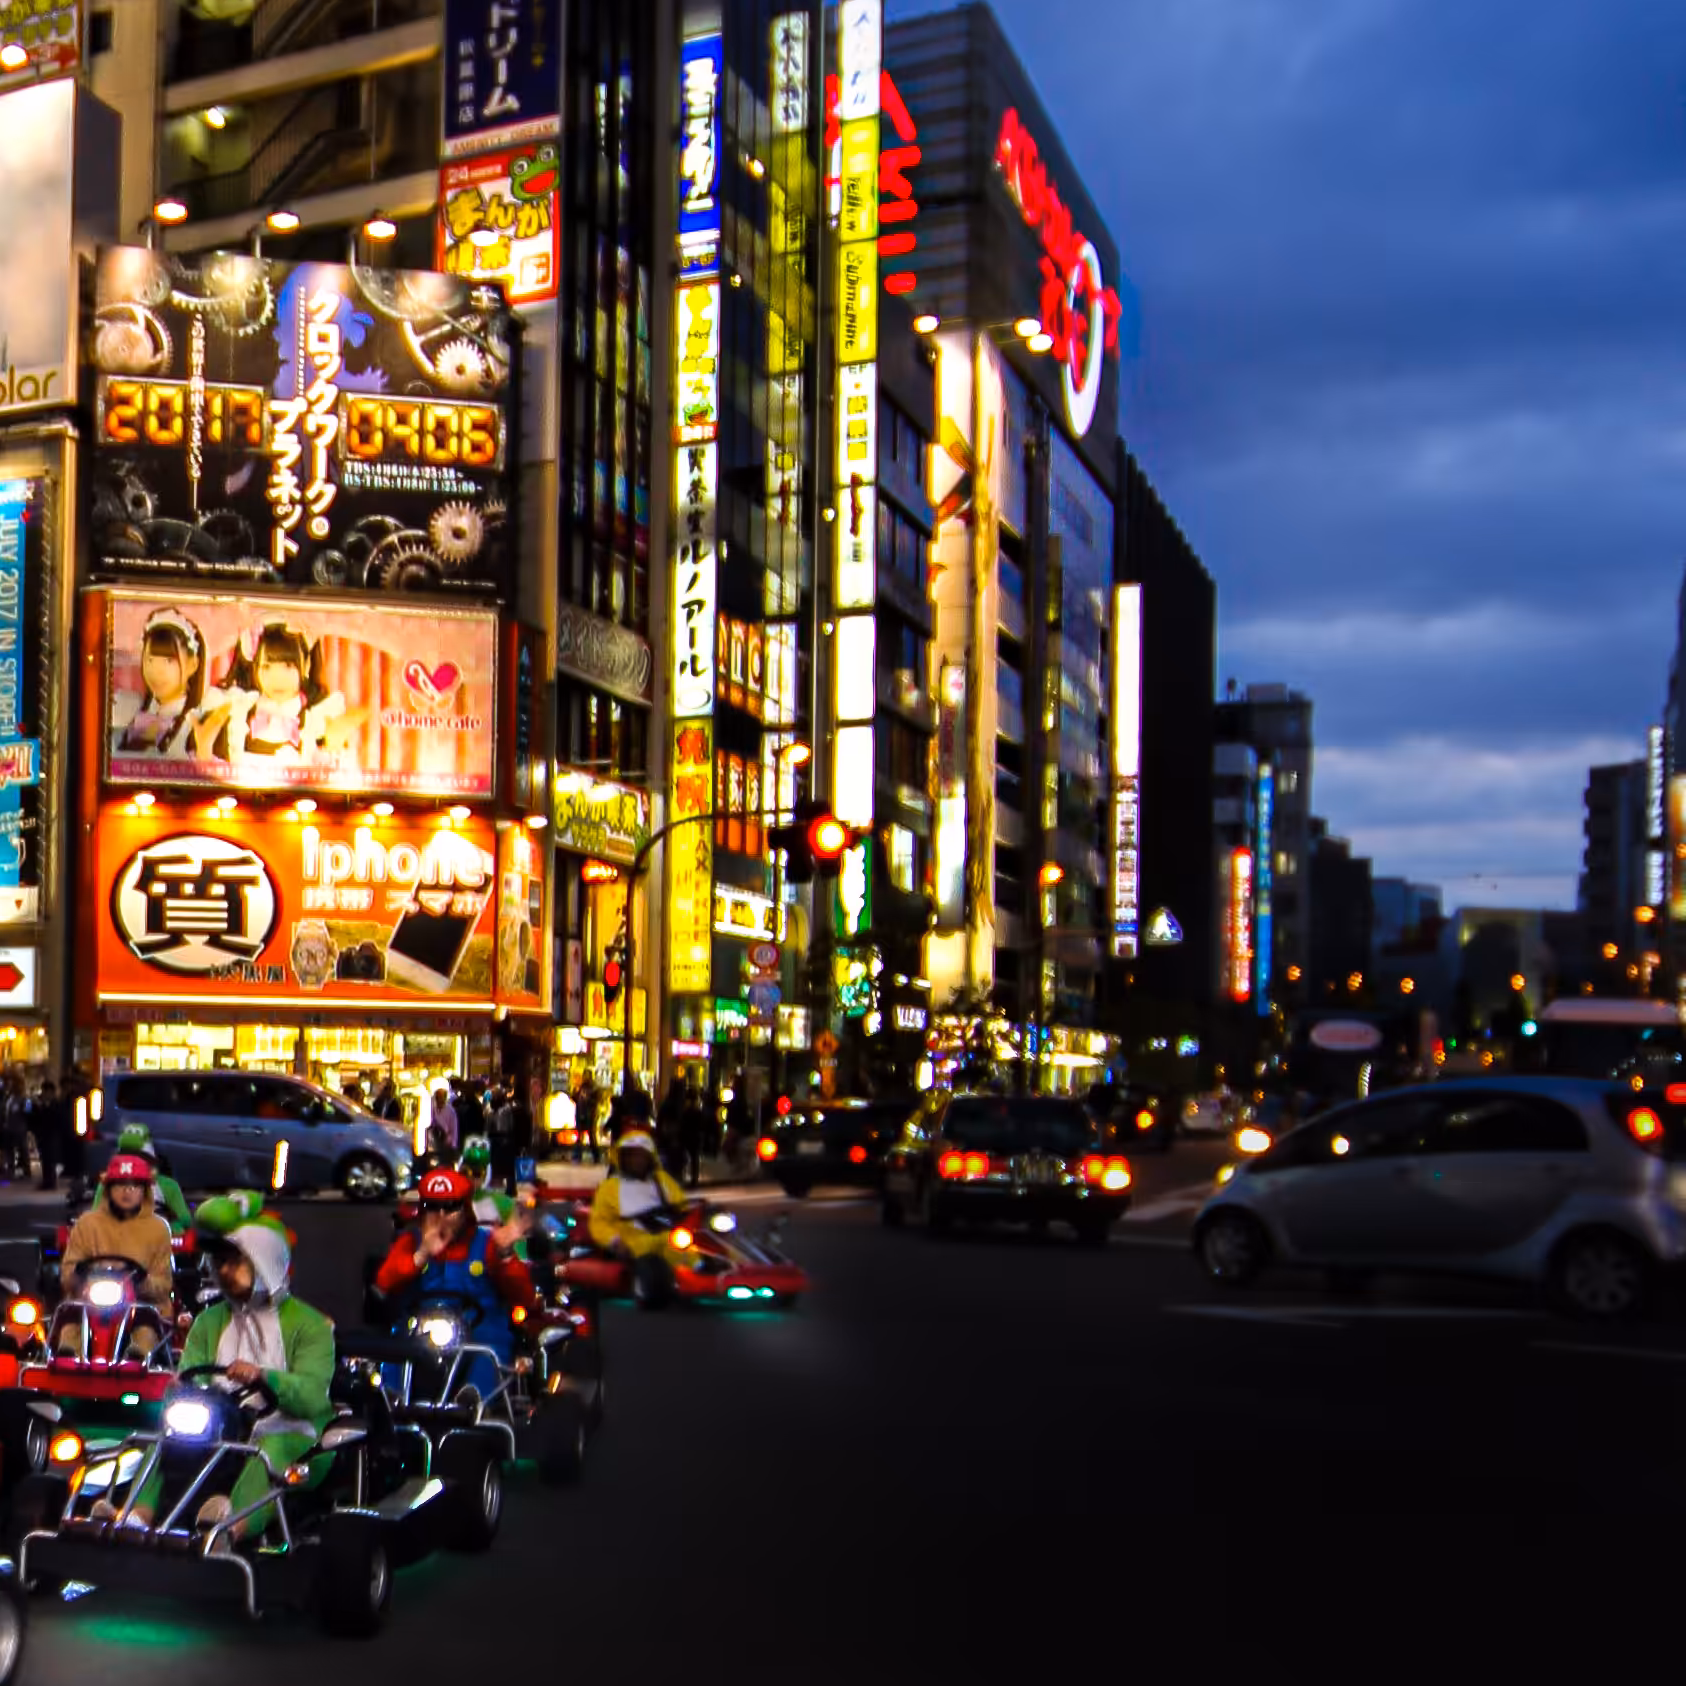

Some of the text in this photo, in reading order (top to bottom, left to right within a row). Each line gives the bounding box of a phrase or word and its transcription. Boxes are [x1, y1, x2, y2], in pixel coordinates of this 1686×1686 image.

[444, 187, 551, 242] まんが
[104, 381, 262, 445] 2017
[345, 396, 498, 465] 0406
[267, 398, 308, 564] プラネット
[130, 850, 265, 961] 質
[385, 888, 487, 917] スマホ
